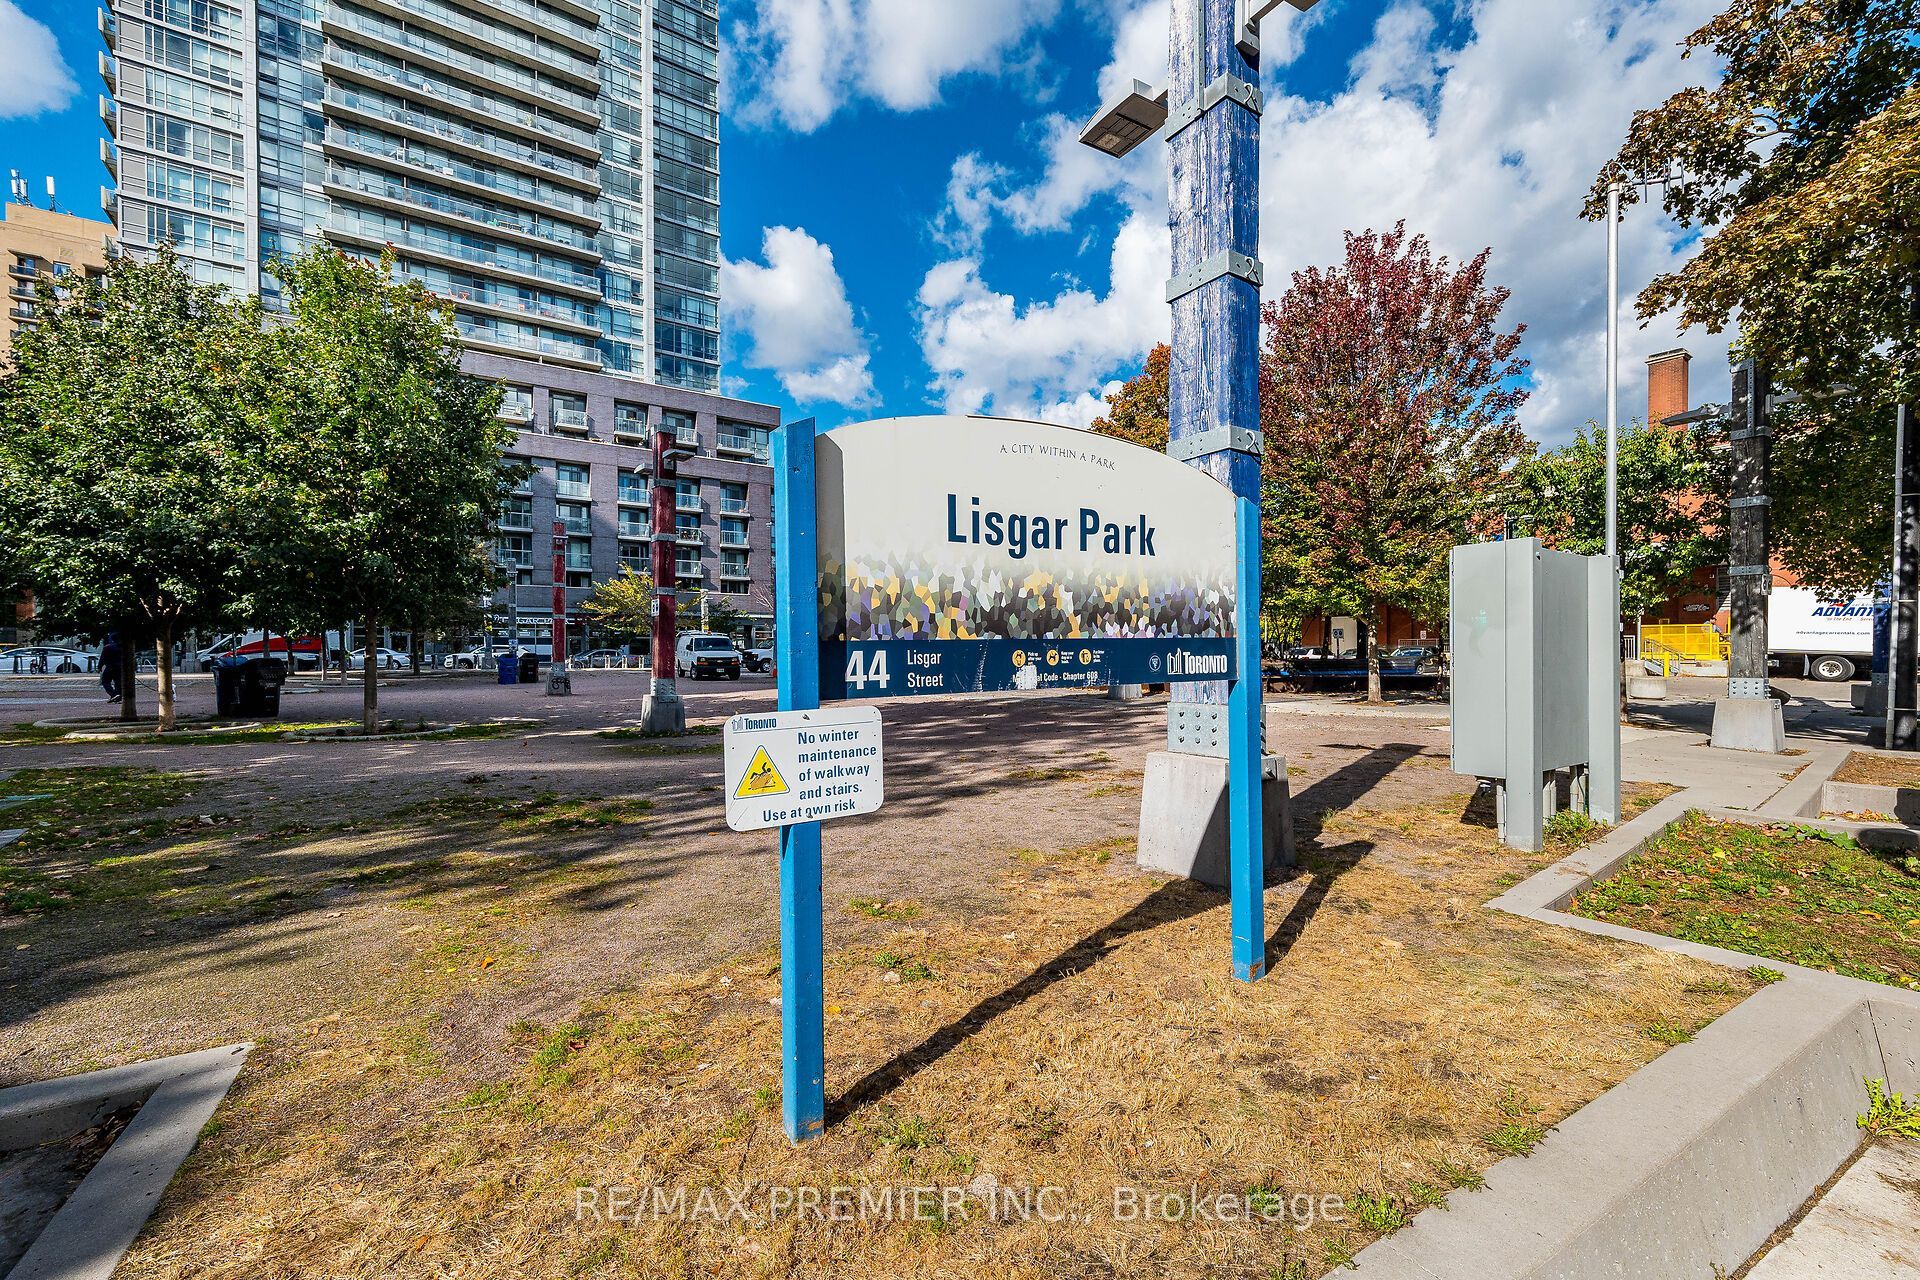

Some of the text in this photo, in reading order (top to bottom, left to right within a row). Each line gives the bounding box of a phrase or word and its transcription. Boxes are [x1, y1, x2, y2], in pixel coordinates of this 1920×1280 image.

[1000, 444, 1115, 471] A CITY WITHIN A PARK
[947, 494, 1156, 559] Lisgar Park
[1811, 602, 1874, 617] ADVANT
[907, 649, 942, 669] Lisgar
[1183, 651, 1228, 675] TORONTO
[844, 650, 891, 689] 44
[1044, 673, 1058, 682] Code
[1062, 671, 1085, 682] Chapter
[907, 672, 944, 689] Street
[744, 718, 777, 730] TORONTO
[797, 729, 859, 745] No winter
[798, 746, 877, 763] maintenance
[799, 764, 870, 782] of walkway
[799, 782, 863, 800] and stairs.
[763, 799, 856, 822] Use at own risk
